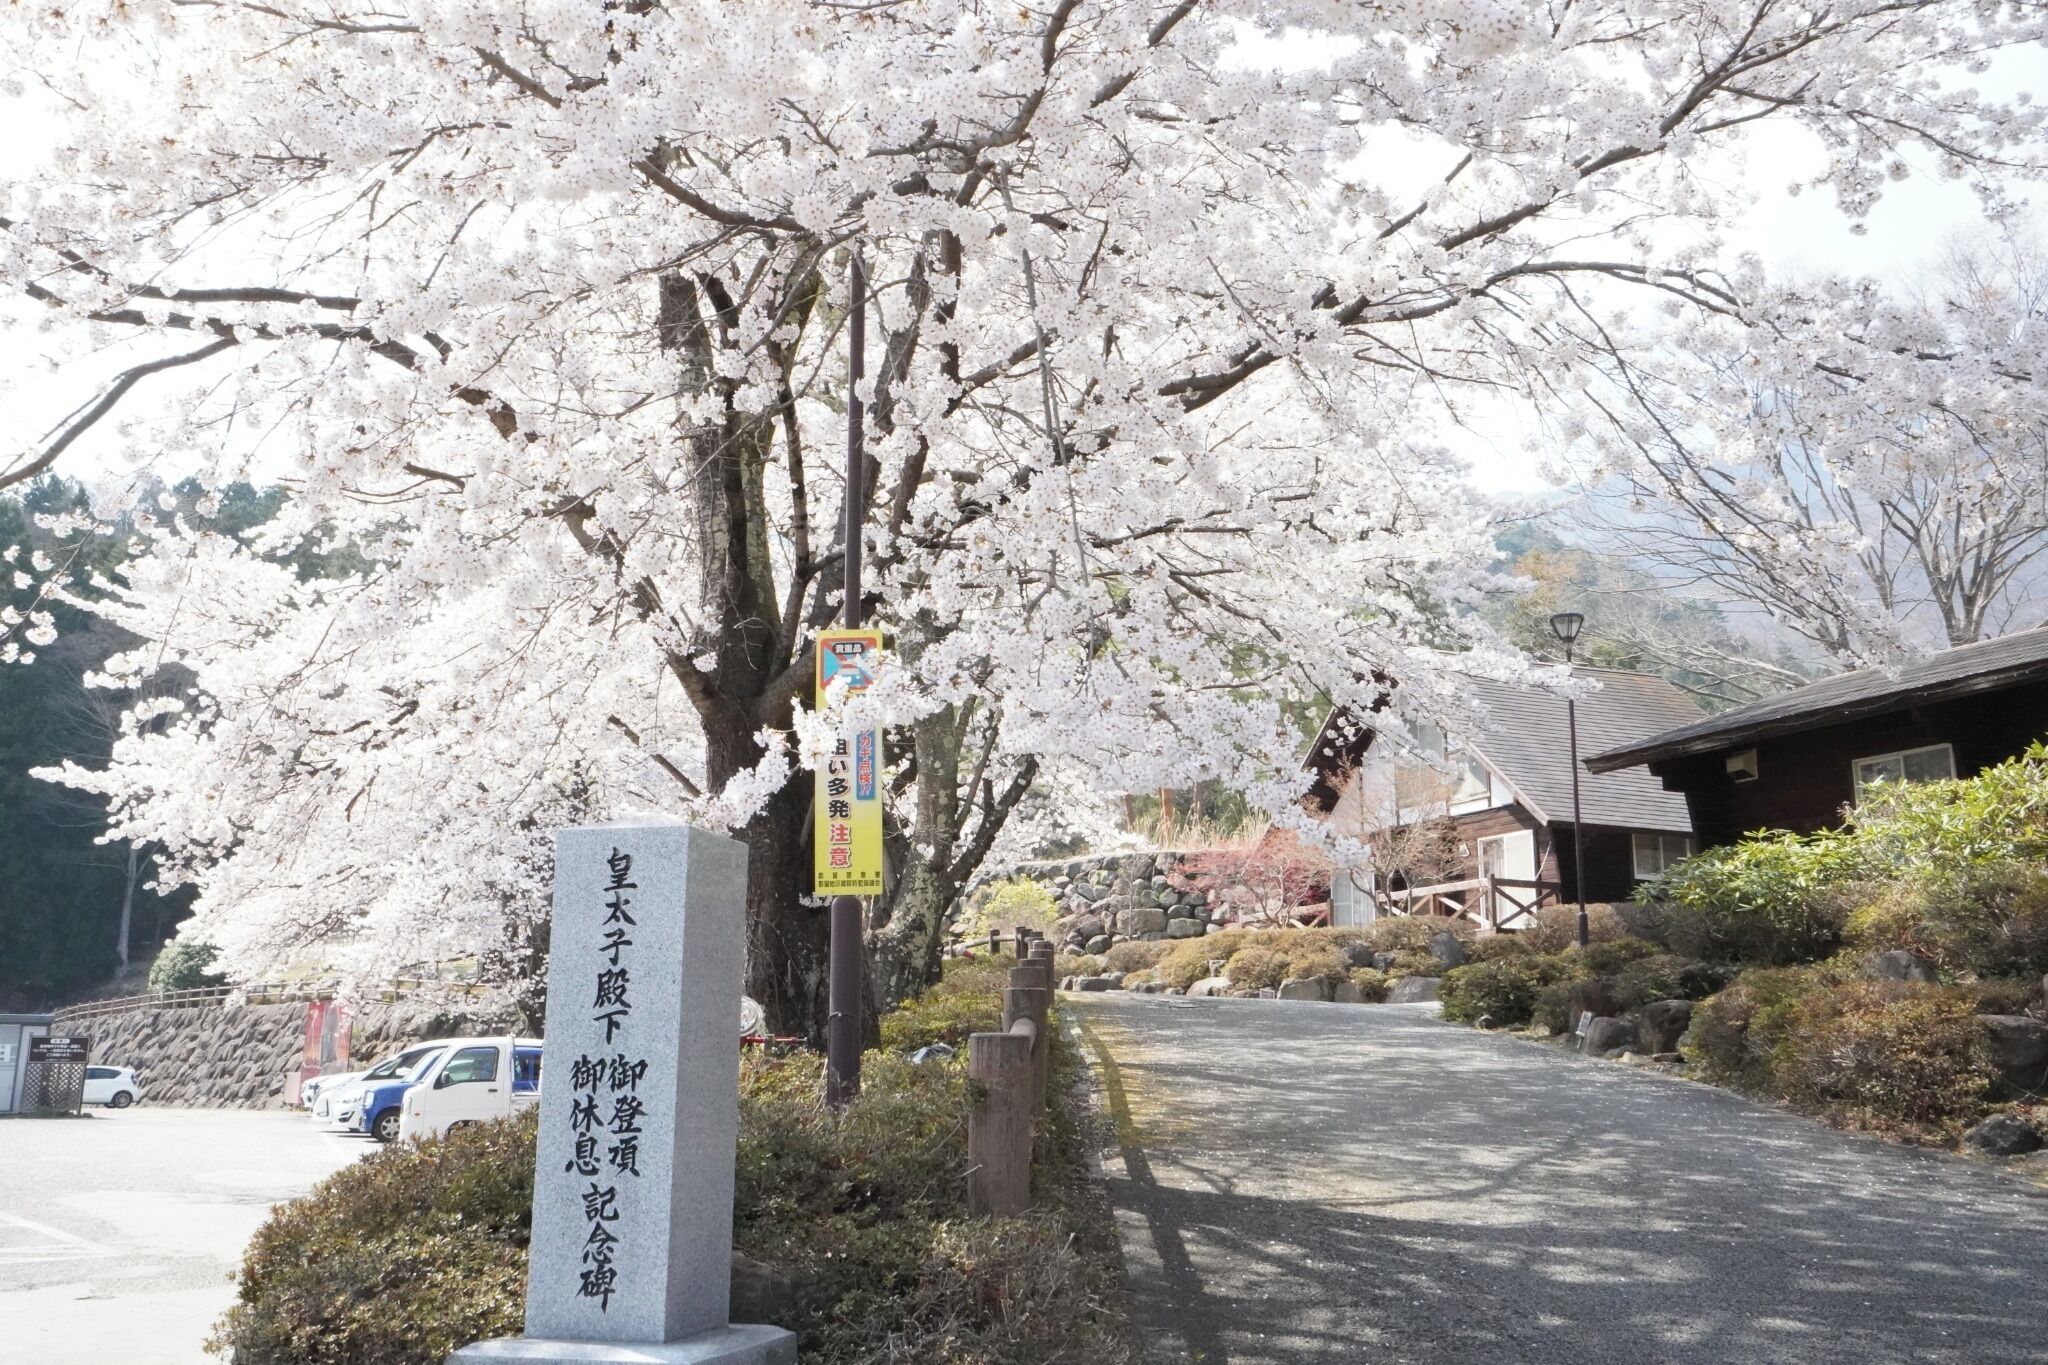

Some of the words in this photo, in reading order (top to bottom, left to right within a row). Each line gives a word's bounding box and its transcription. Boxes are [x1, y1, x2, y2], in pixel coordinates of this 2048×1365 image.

[593, 846, 639, 1046] 皇太子殿下
[564, 1053, 608, 1176] 御休息
[607, 1053, 649, 1177] 御登頂
[575, 1181, 620, 1315] 記念碑
